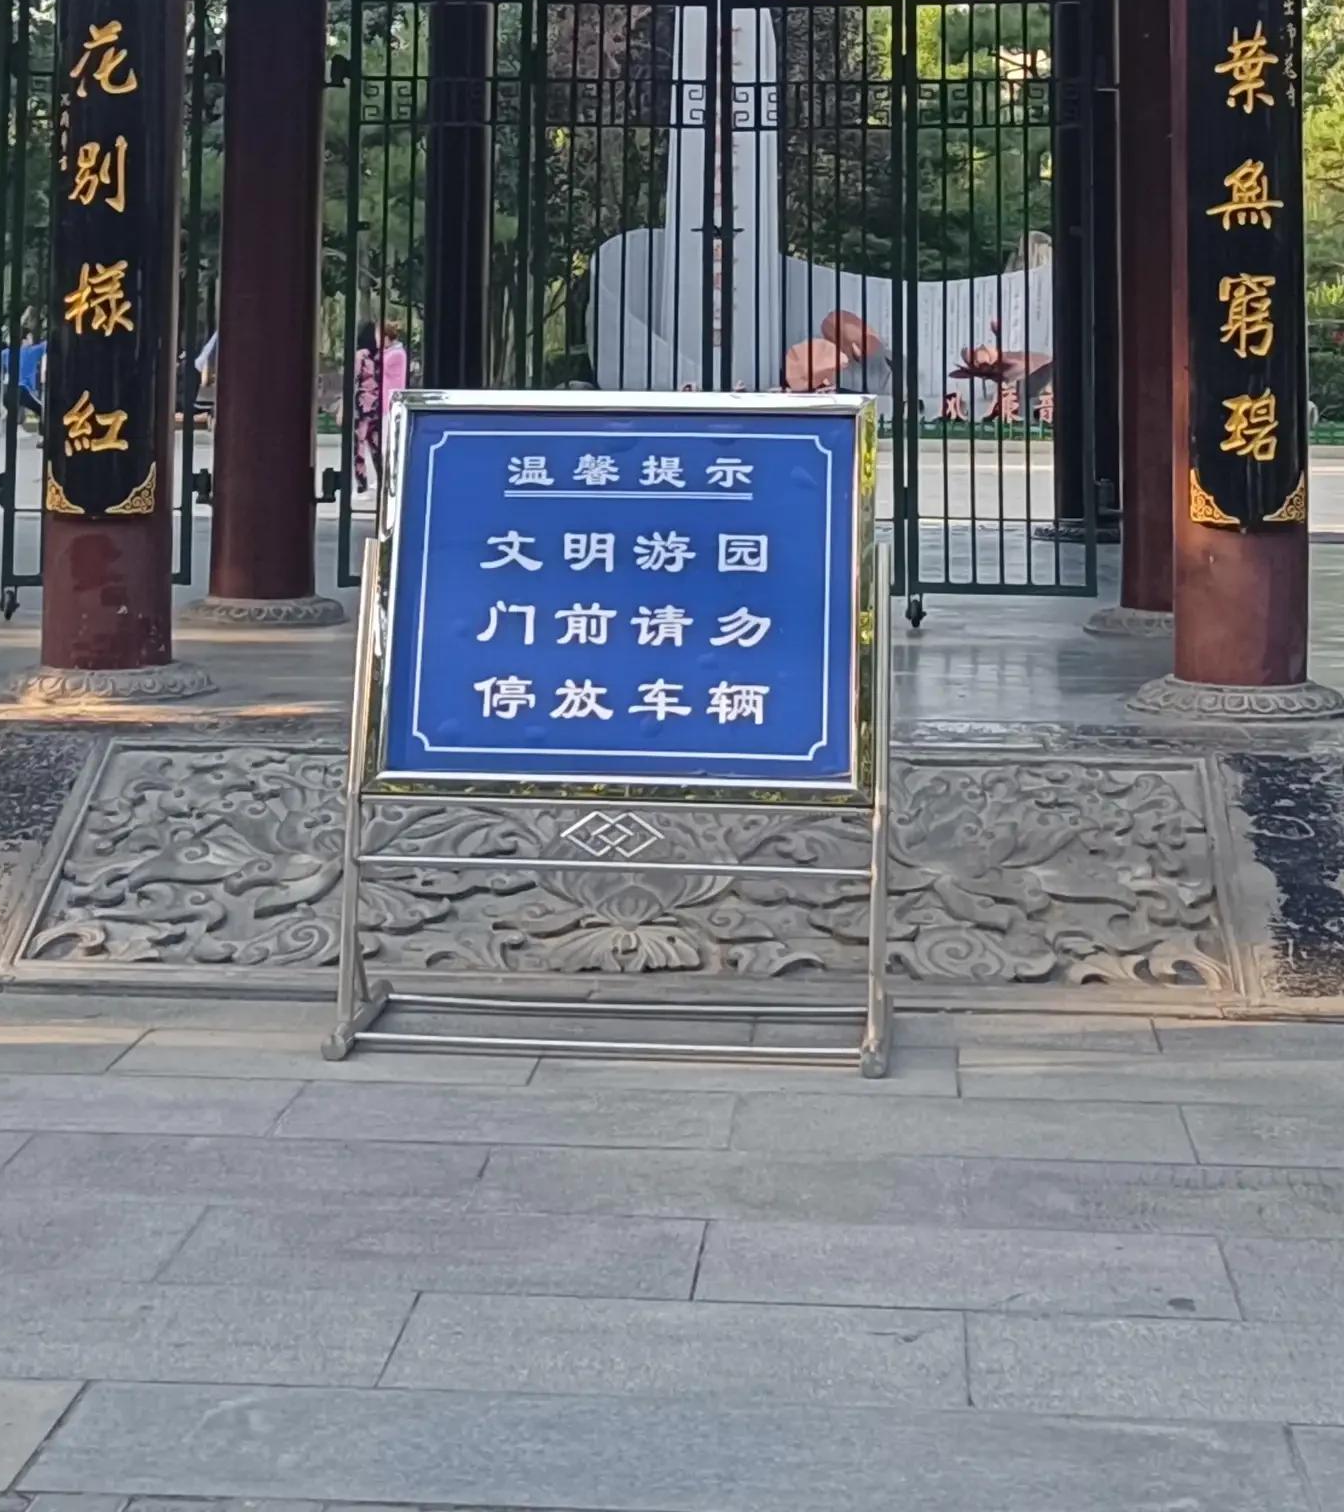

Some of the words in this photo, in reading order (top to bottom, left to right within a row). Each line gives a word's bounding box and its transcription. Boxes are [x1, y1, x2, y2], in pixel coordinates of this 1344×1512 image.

[507, 454, 754, 488] 温馨提示
[480, 530, 768, 573] 文明游园
[476, 600, 771, 647] 门前请勿
[474, 675, 770, 725] 停放车辆
